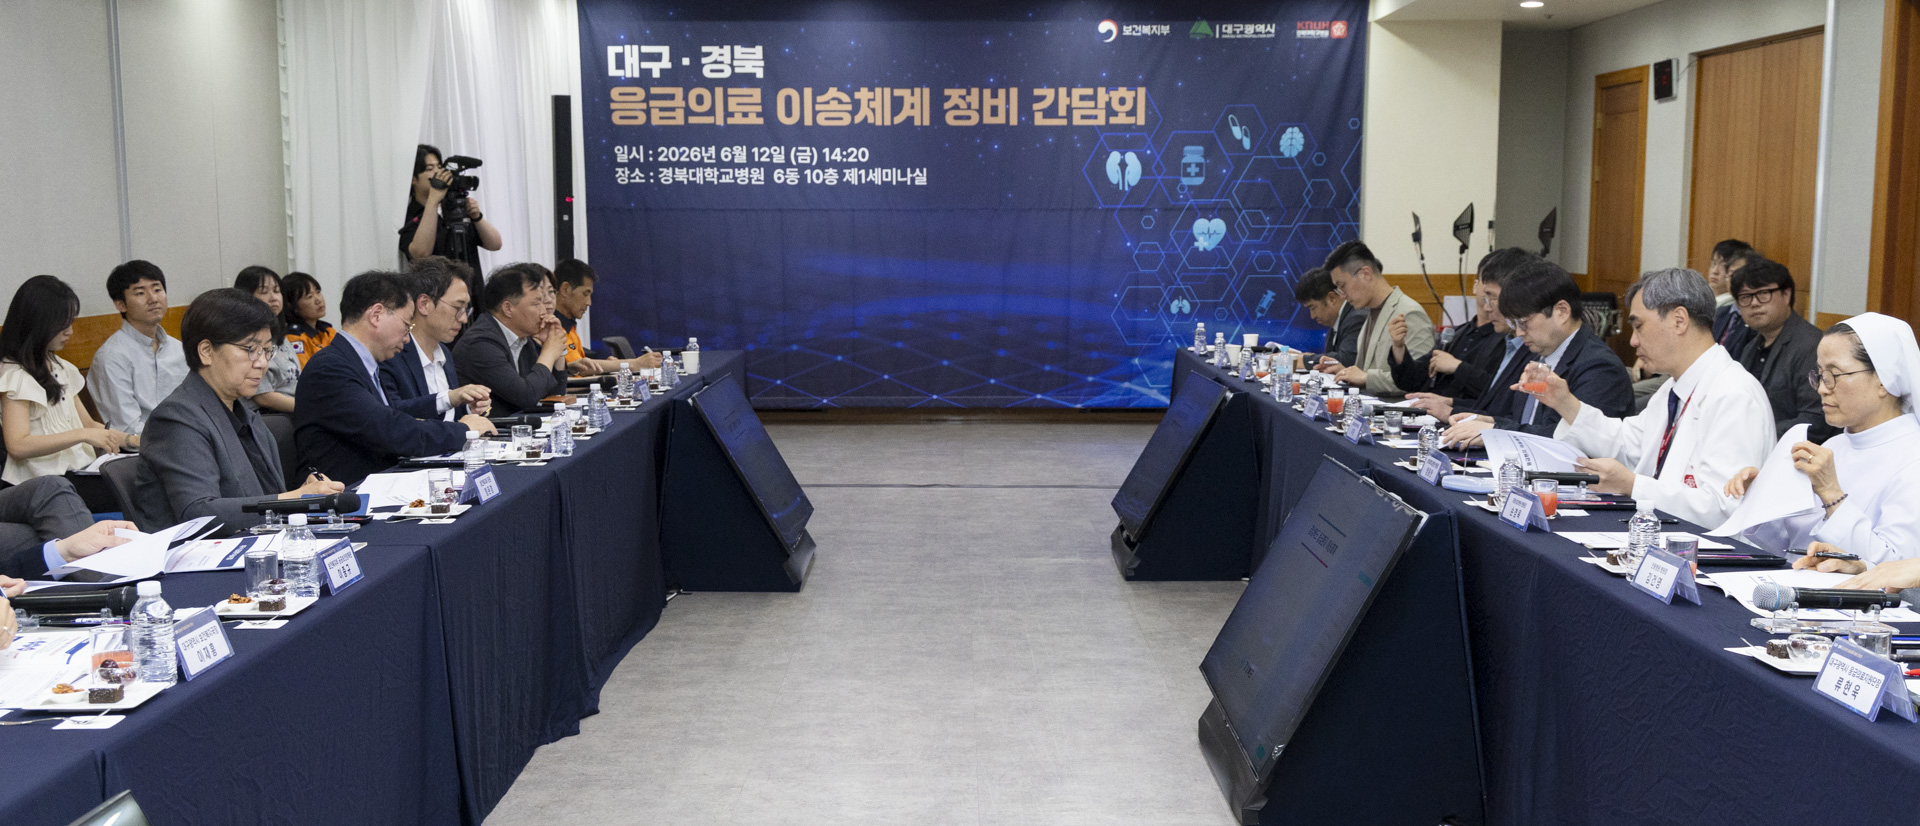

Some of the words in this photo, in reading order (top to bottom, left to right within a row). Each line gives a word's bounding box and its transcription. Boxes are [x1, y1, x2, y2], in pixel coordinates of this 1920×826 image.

[1122, 24, 1171, 36] 보건복지부
[1221, 23, 1276, 35] 대구광역시
[607, 45, 671, 80] 대구
[701, 45, 765, 79] 경북
[611, 87, 764, 125] 응급의료
[777, 87, 930, 126] 이송체계
[943, 87, 1018, 126] 정비
[1032, 87, 1146, 126] 간담회
[614, 145, 644, 163] 일시
[657, 146, 716, 163] 2026년
[721, 146, 747, 163] 6월
[752, 146, 786, 163] 12일
[791, 147, 818, 165] (금)
[823, 148, 870, 162] 14:20
[615, 166, 646, 184] 장소
[658, 167, 765, 185] 경북대학교병원
[773, 168, 800, 185] 6동
[804, 168, 839, 185] 10층
[843, 168, 928, 186] 제1세미나실
[182, 637, 199, 651] 대구광역시
[199, 626, 219, 642] 보건복지국장
[197, 643, 218, 663] 이재홍
[1829, 657, 1849, 673] 대구광역시
[1848, 666, 1882, 689] 응급의료지원단장
[1834, 676, 1861, 700] 류현욱
